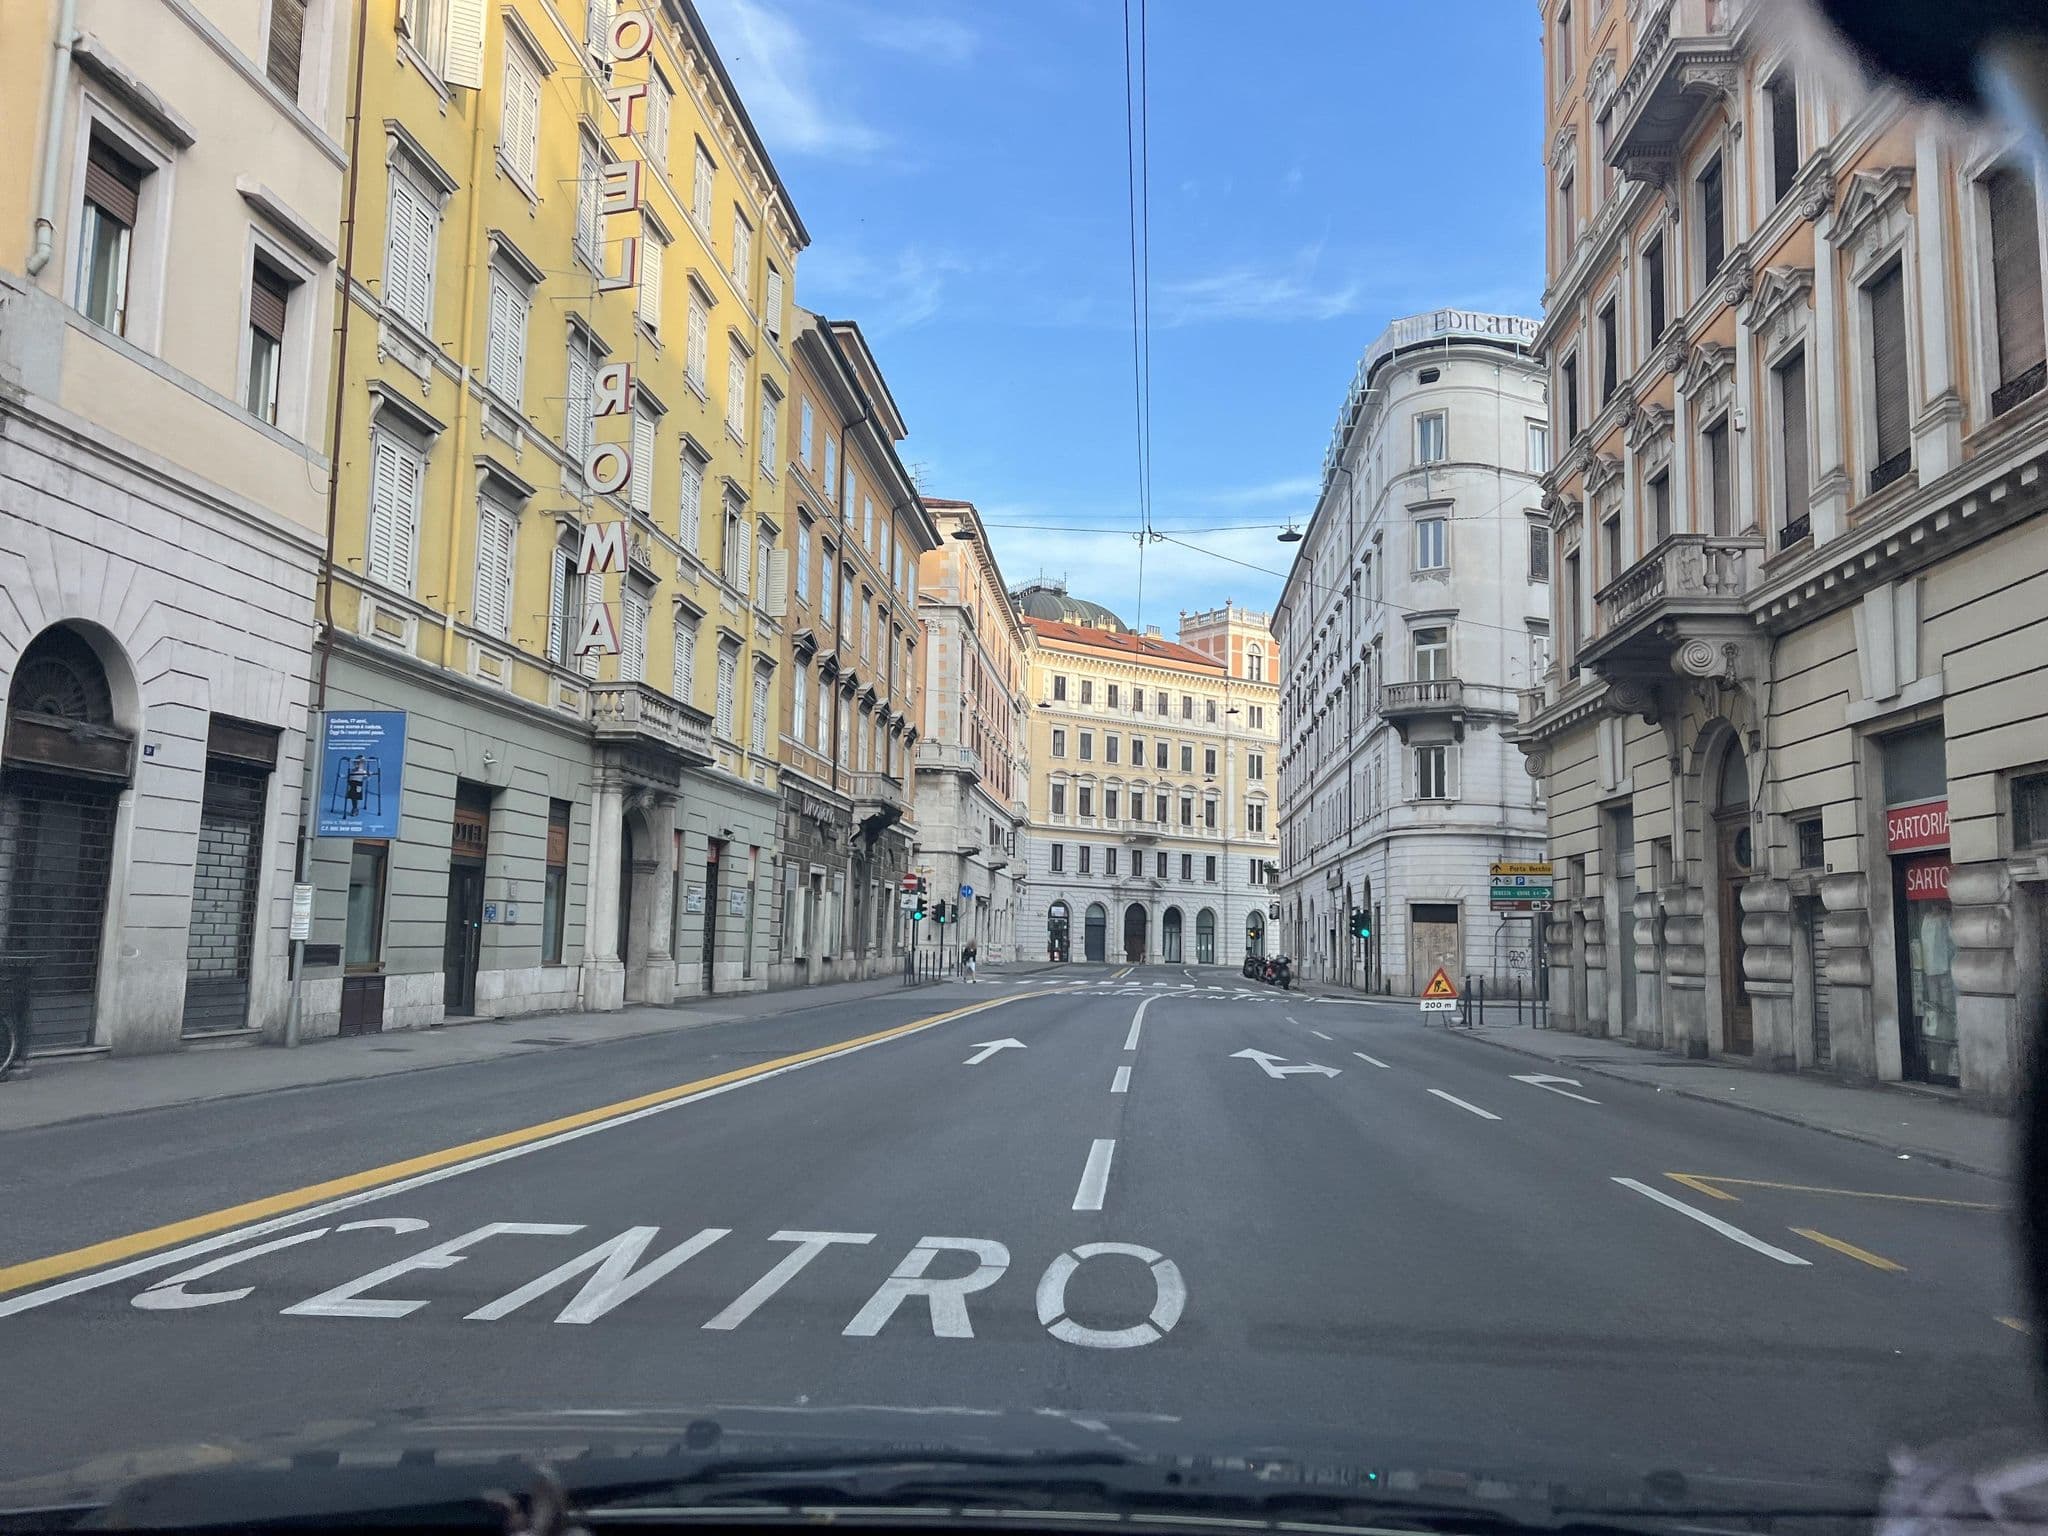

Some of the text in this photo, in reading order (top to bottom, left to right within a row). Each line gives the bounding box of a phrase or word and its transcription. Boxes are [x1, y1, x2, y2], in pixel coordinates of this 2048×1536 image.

[1889, 811, 1950, 841] SARTORIA
[1425, 1001, 1442, 1009] 200
[130, 1217, 1188, 1348] CENTRO
